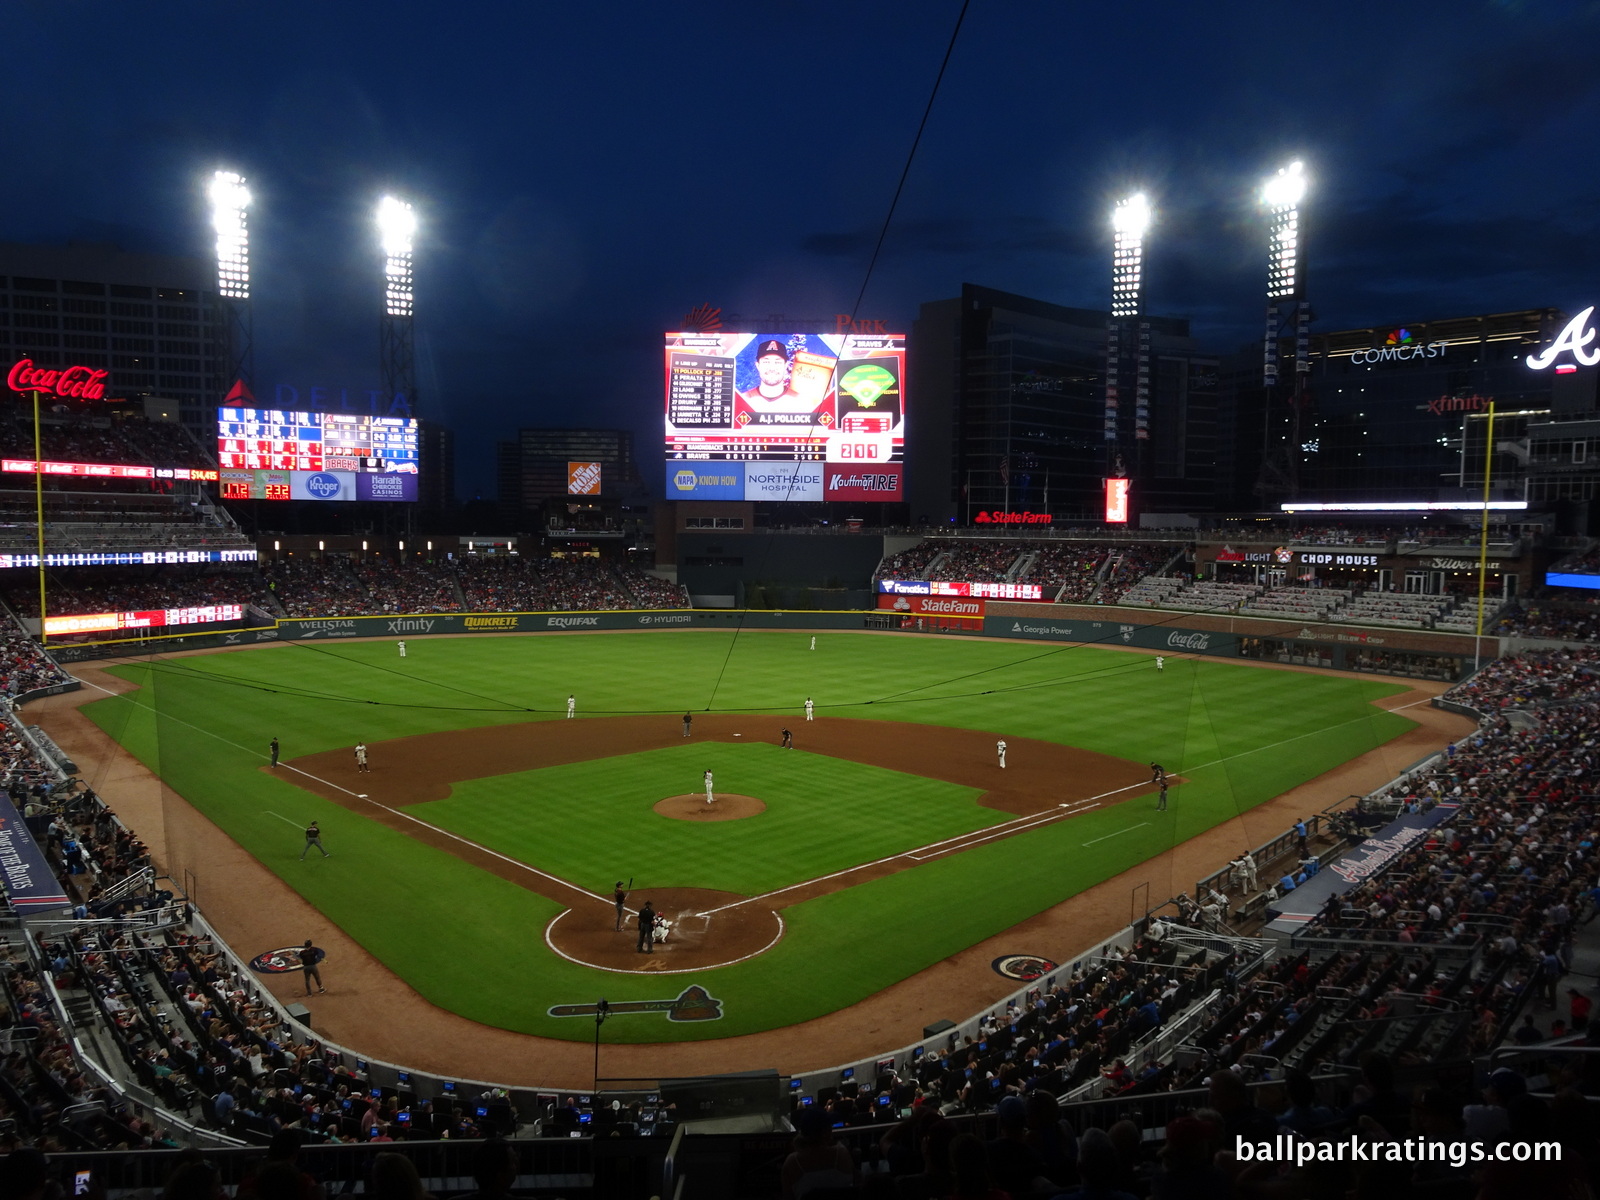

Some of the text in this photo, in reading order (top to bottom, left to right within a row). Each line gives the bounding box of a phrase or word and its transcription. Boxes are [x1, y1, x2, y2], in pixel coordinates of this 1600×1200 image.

[834, 314, 888, 334] PARK
[1351, 342, 1449, 365] COMCAST
[8, 358, 109, 400] Coca-Cola
[275, 384, 412, 417] DELTA
[1427, 394, 1494, 416] xfinity
[759, 414, 810, 424] A.J. POLLOCK
[842, 444, 850, 458] 2
[568, 462, 600, 494] HOME
[572, 466, 586, 479] THE
[372, 476, 402, 484] Harrah's
[581, 474, 600, 494] DEPOT
[678, 476, 694, 485] NAPA
[698, 476, 736, 486] KNOW HOW
[748, 475, 820, 484] NORTHSIDE
[862, 475, 898, 490] TIRE
[226, 484, 247, 494] 172
[266, 485, 288, 494] 232
[310, 478, 338, 496] Kroger
[992, 511, 1052, 524] StateFarm
[1245, 552, 1271, 562] LIGHT
[1300, 554, 1378, 566] CHOP HOUSE
[1432, 557, 1473, 570] Silver
[894, 584, 928, 594] Fanatics
[921, 599, 980, 614] StateFarm
[300, 620, 356, 630] WELLSTAR
[388, 618, 434, 634] xfinity
[464, 617, 518, 627] QUIKRETE
[548, 616, 598, 628] EQUIFAX
[1022, 625, 1072, 635] Georgia Power
[1167, 630, 1210, 650] Coca-Cola
[5, 863, 34, 890] BRAVES
[213, 1064, 226, 1074] 20
